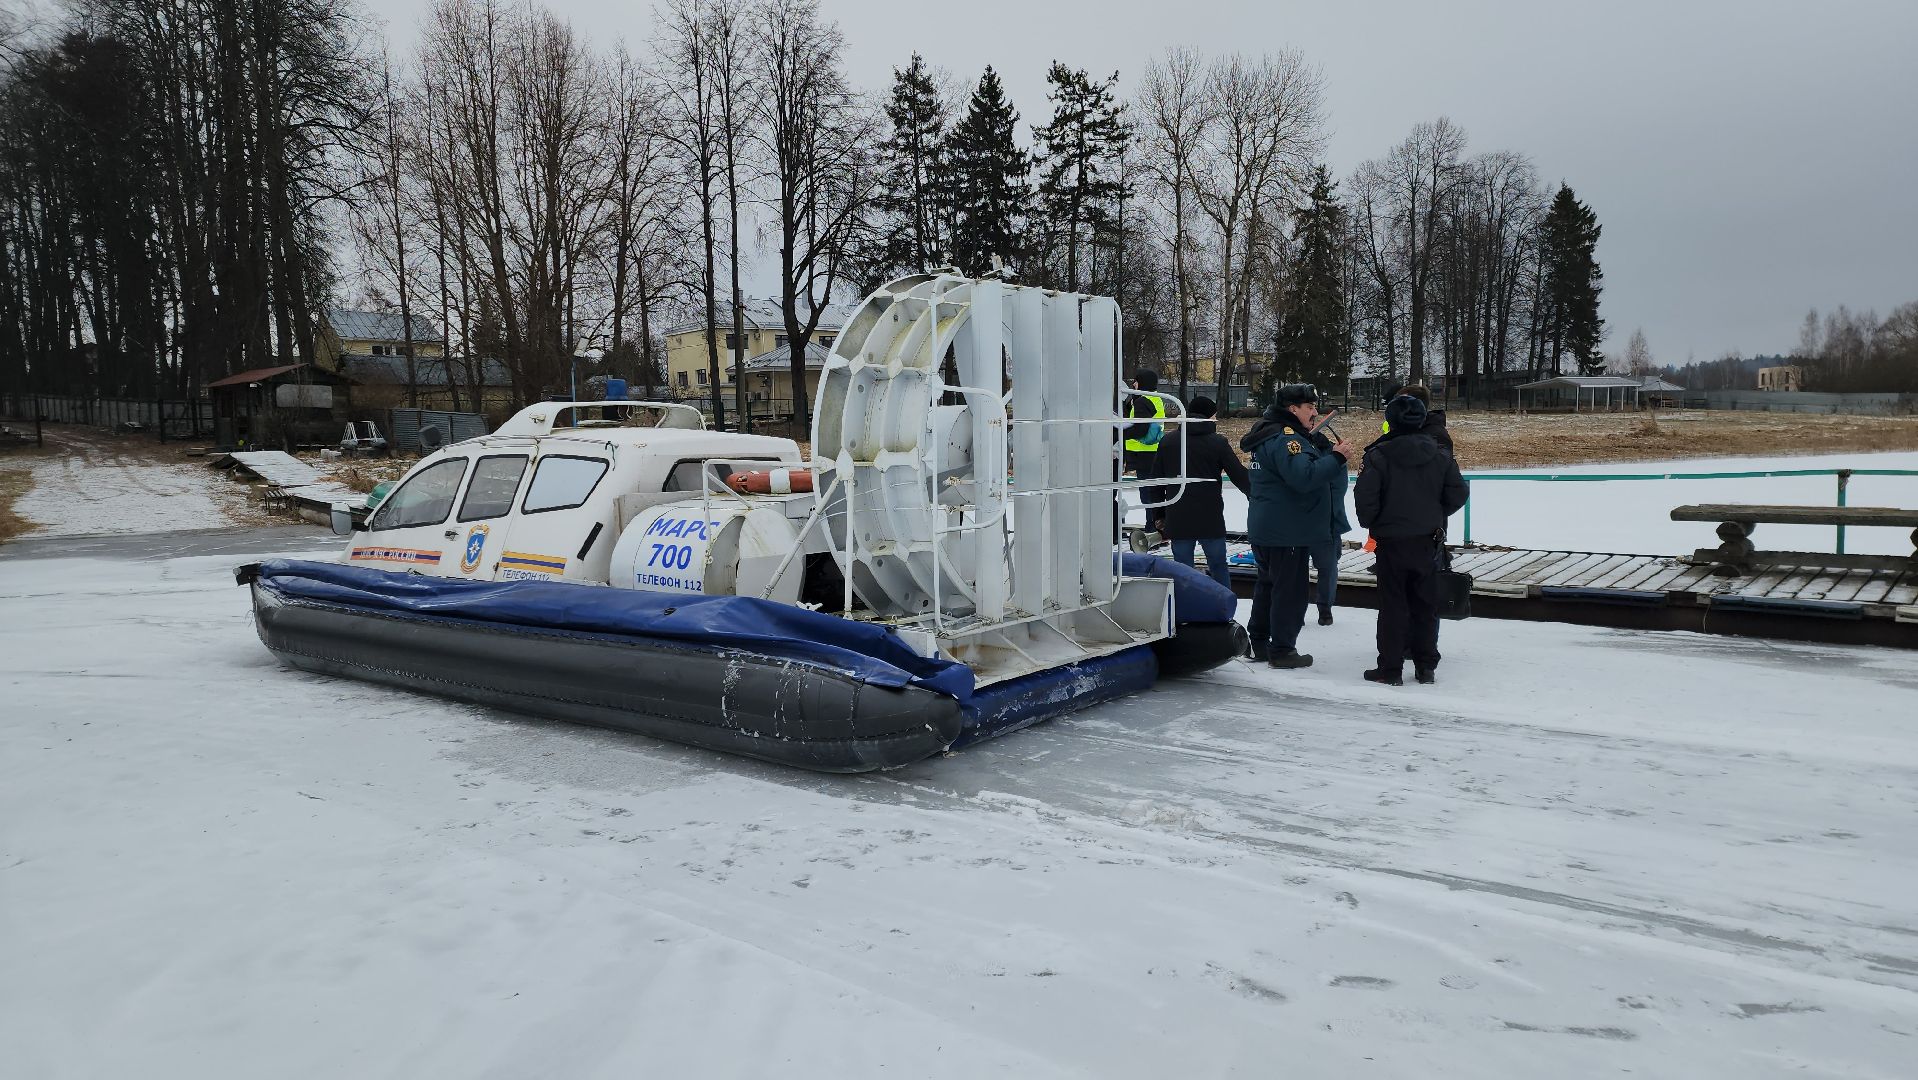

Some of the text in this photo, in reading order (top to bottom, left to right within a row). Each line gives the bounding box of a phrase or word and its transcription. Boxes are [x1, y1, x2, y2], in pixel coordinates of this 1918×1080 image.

[647, 518, 720, 540] МАРС
[388, 550, 417, 562] РОССИИ
[647, 543, 693, 570] 700
[502, 569, 538, 581] ТЕЛЕФОН
[636, 573, 703, 592] ТЕЛЕФОН 112
